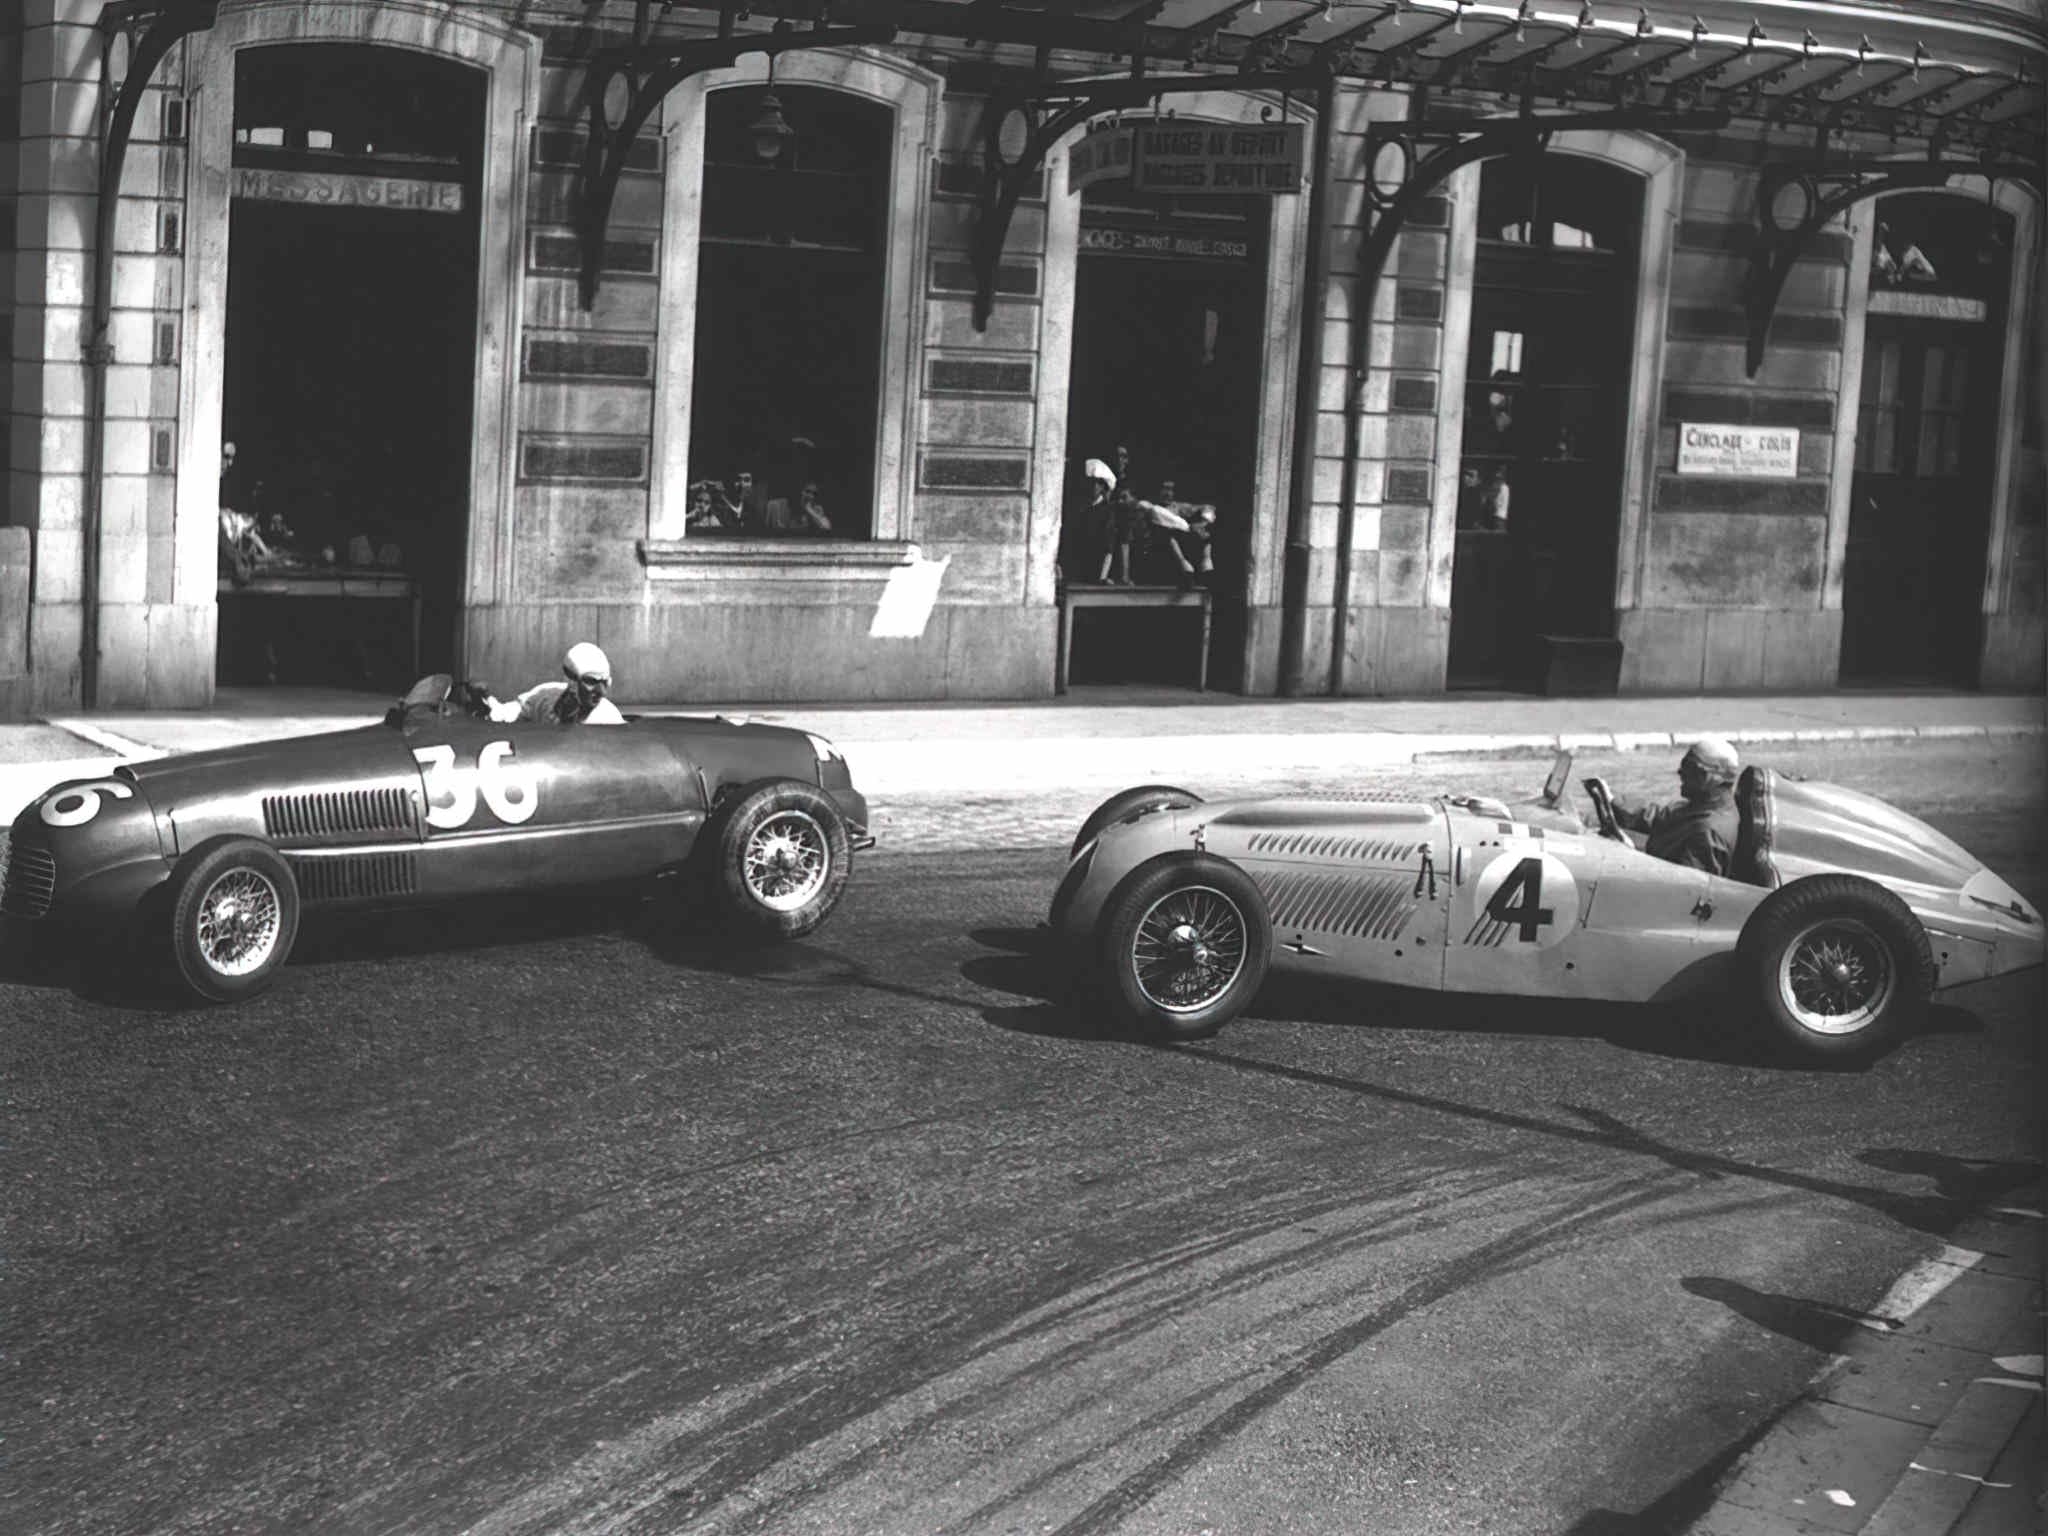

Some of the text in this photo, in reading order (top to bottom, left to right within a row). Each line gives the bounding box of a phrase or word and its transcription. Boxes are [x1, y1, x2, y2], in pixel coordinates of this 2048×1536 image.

[38, 781, 133, 827] 6
[412, 740, 539, 829] 36
[1486, 857, 1554, 942] 4
